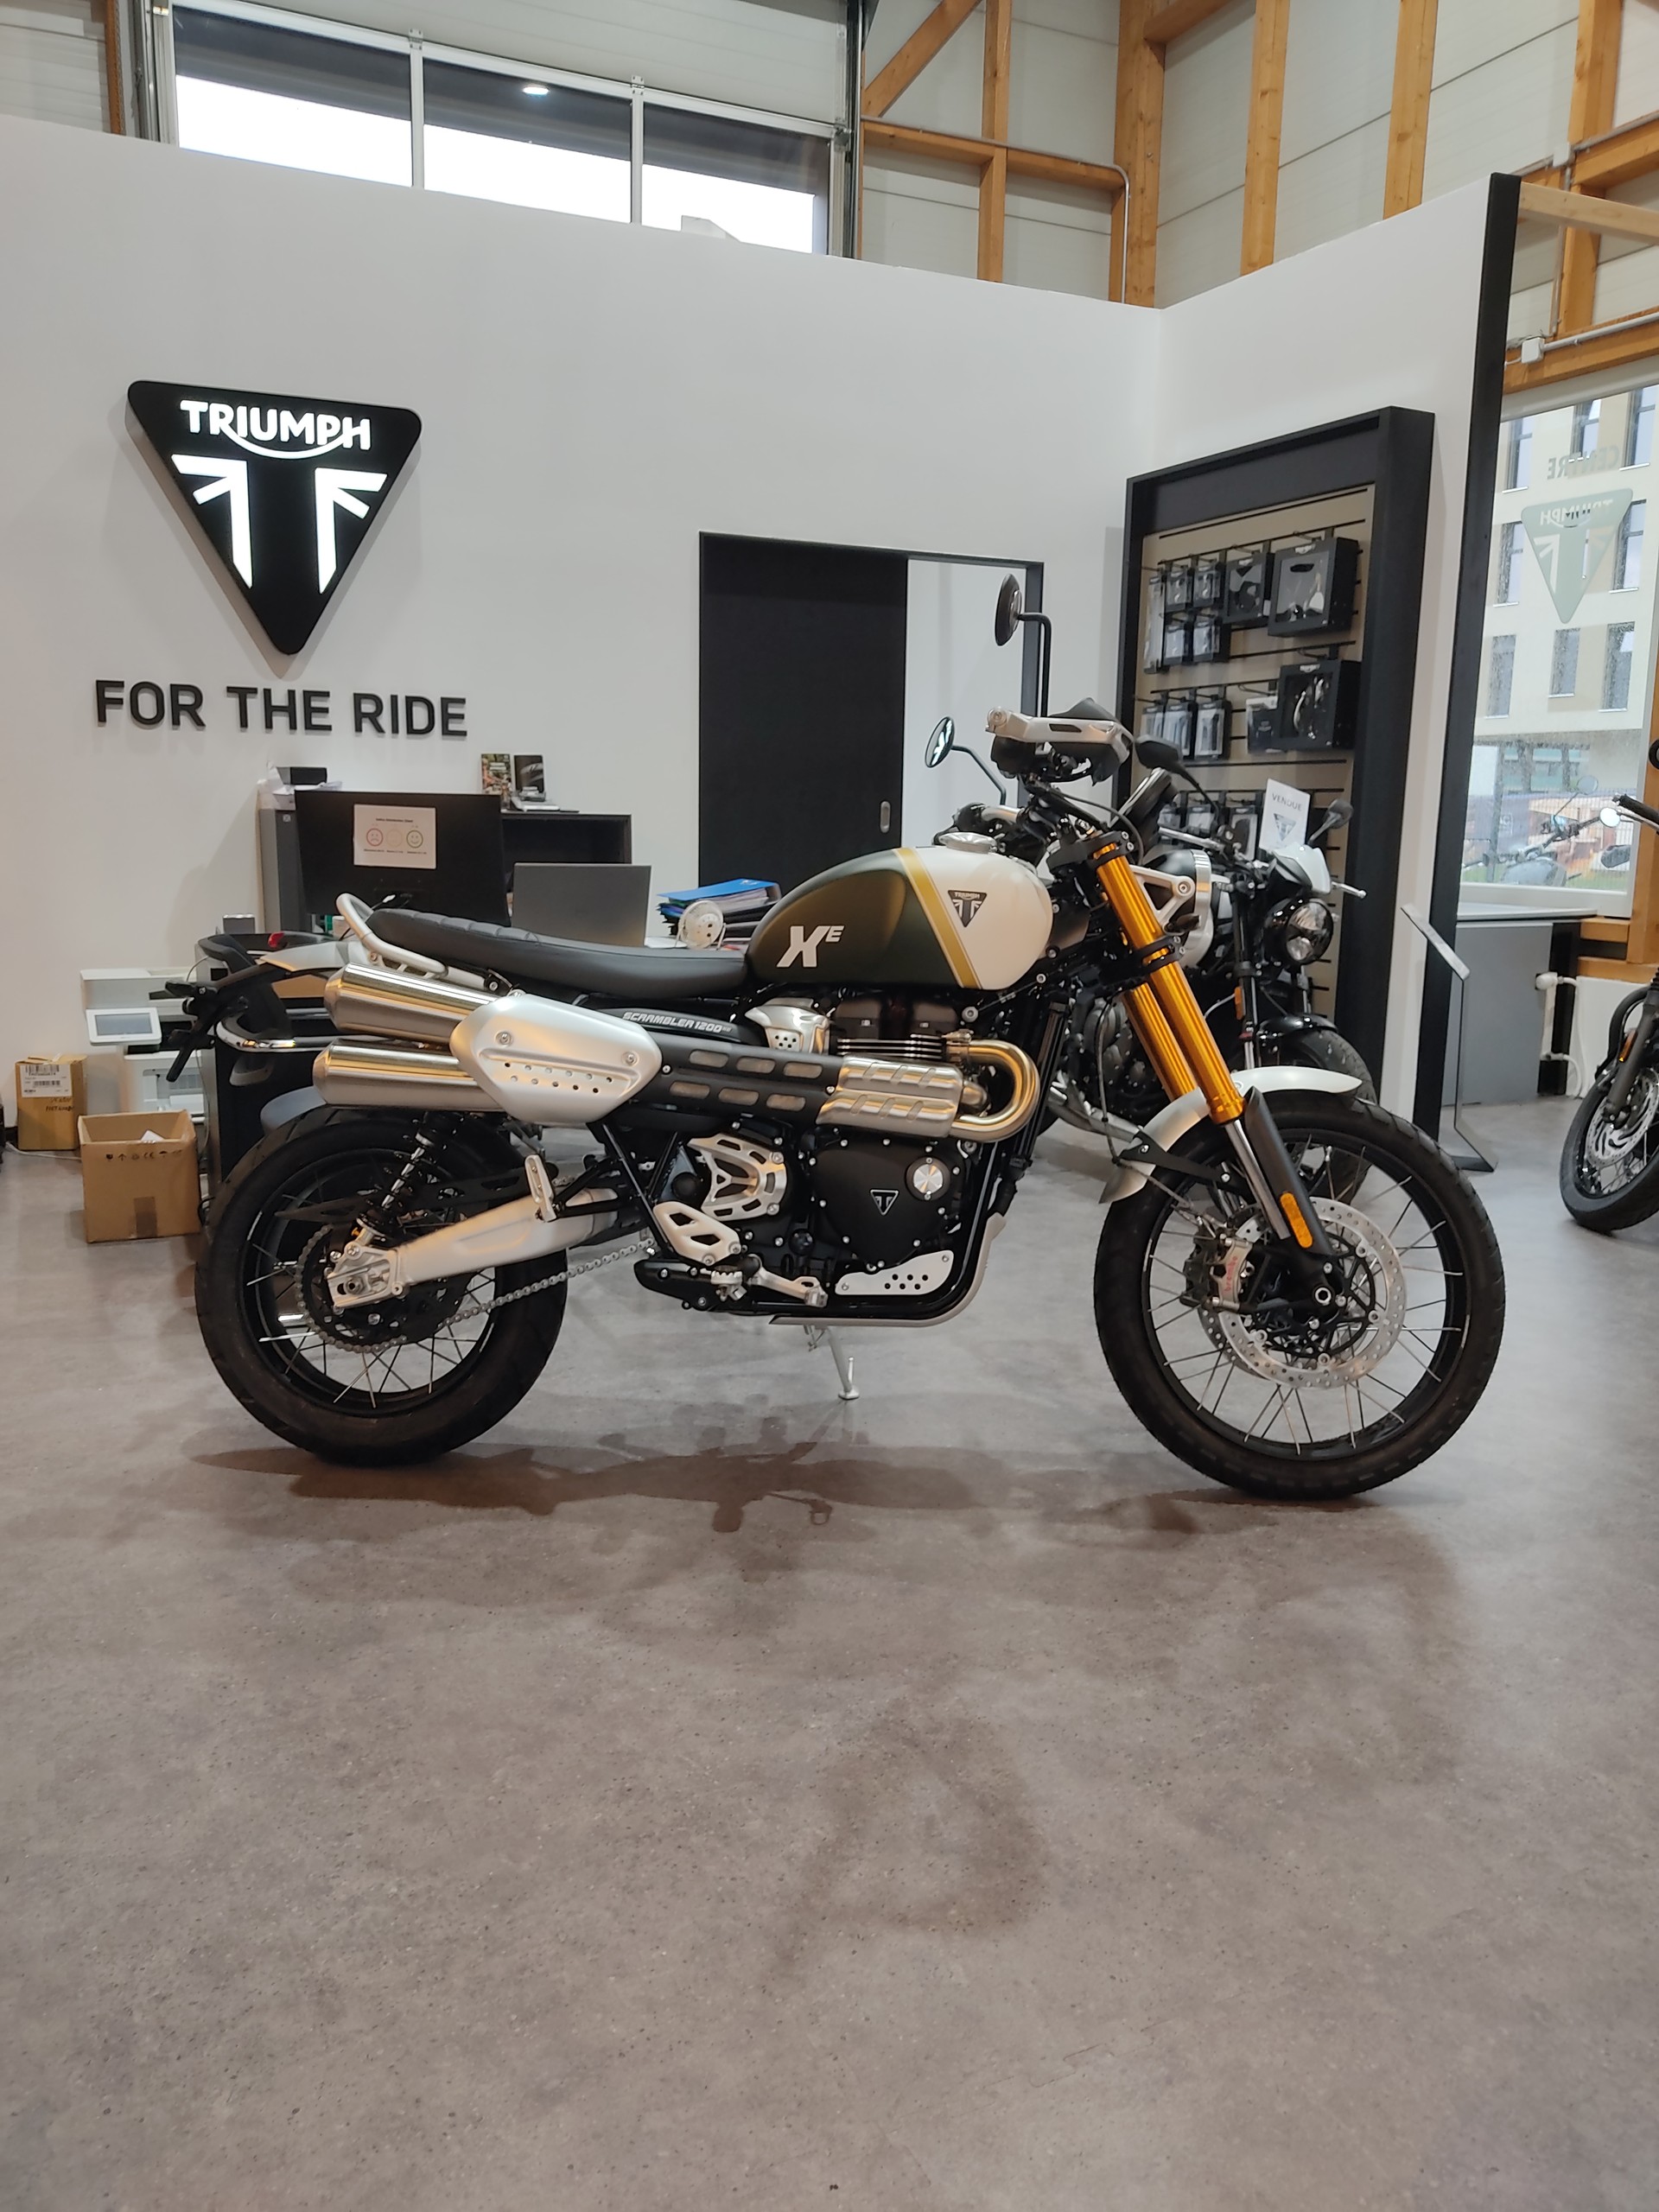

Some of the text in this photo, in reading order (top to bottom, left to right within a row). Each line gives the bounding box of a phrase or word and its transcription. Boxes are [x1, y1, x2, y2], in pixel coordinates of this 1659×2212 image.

[180, 400, 371, 460] TRIUMPH
[95, 679, 468, 737] FOR THE RIDE
[1272, 792, 1303, 812] VENDUE
[622, 1011, 695, 1028] SCRAMBLER
[694, 1021, 722, 1033] 1200
